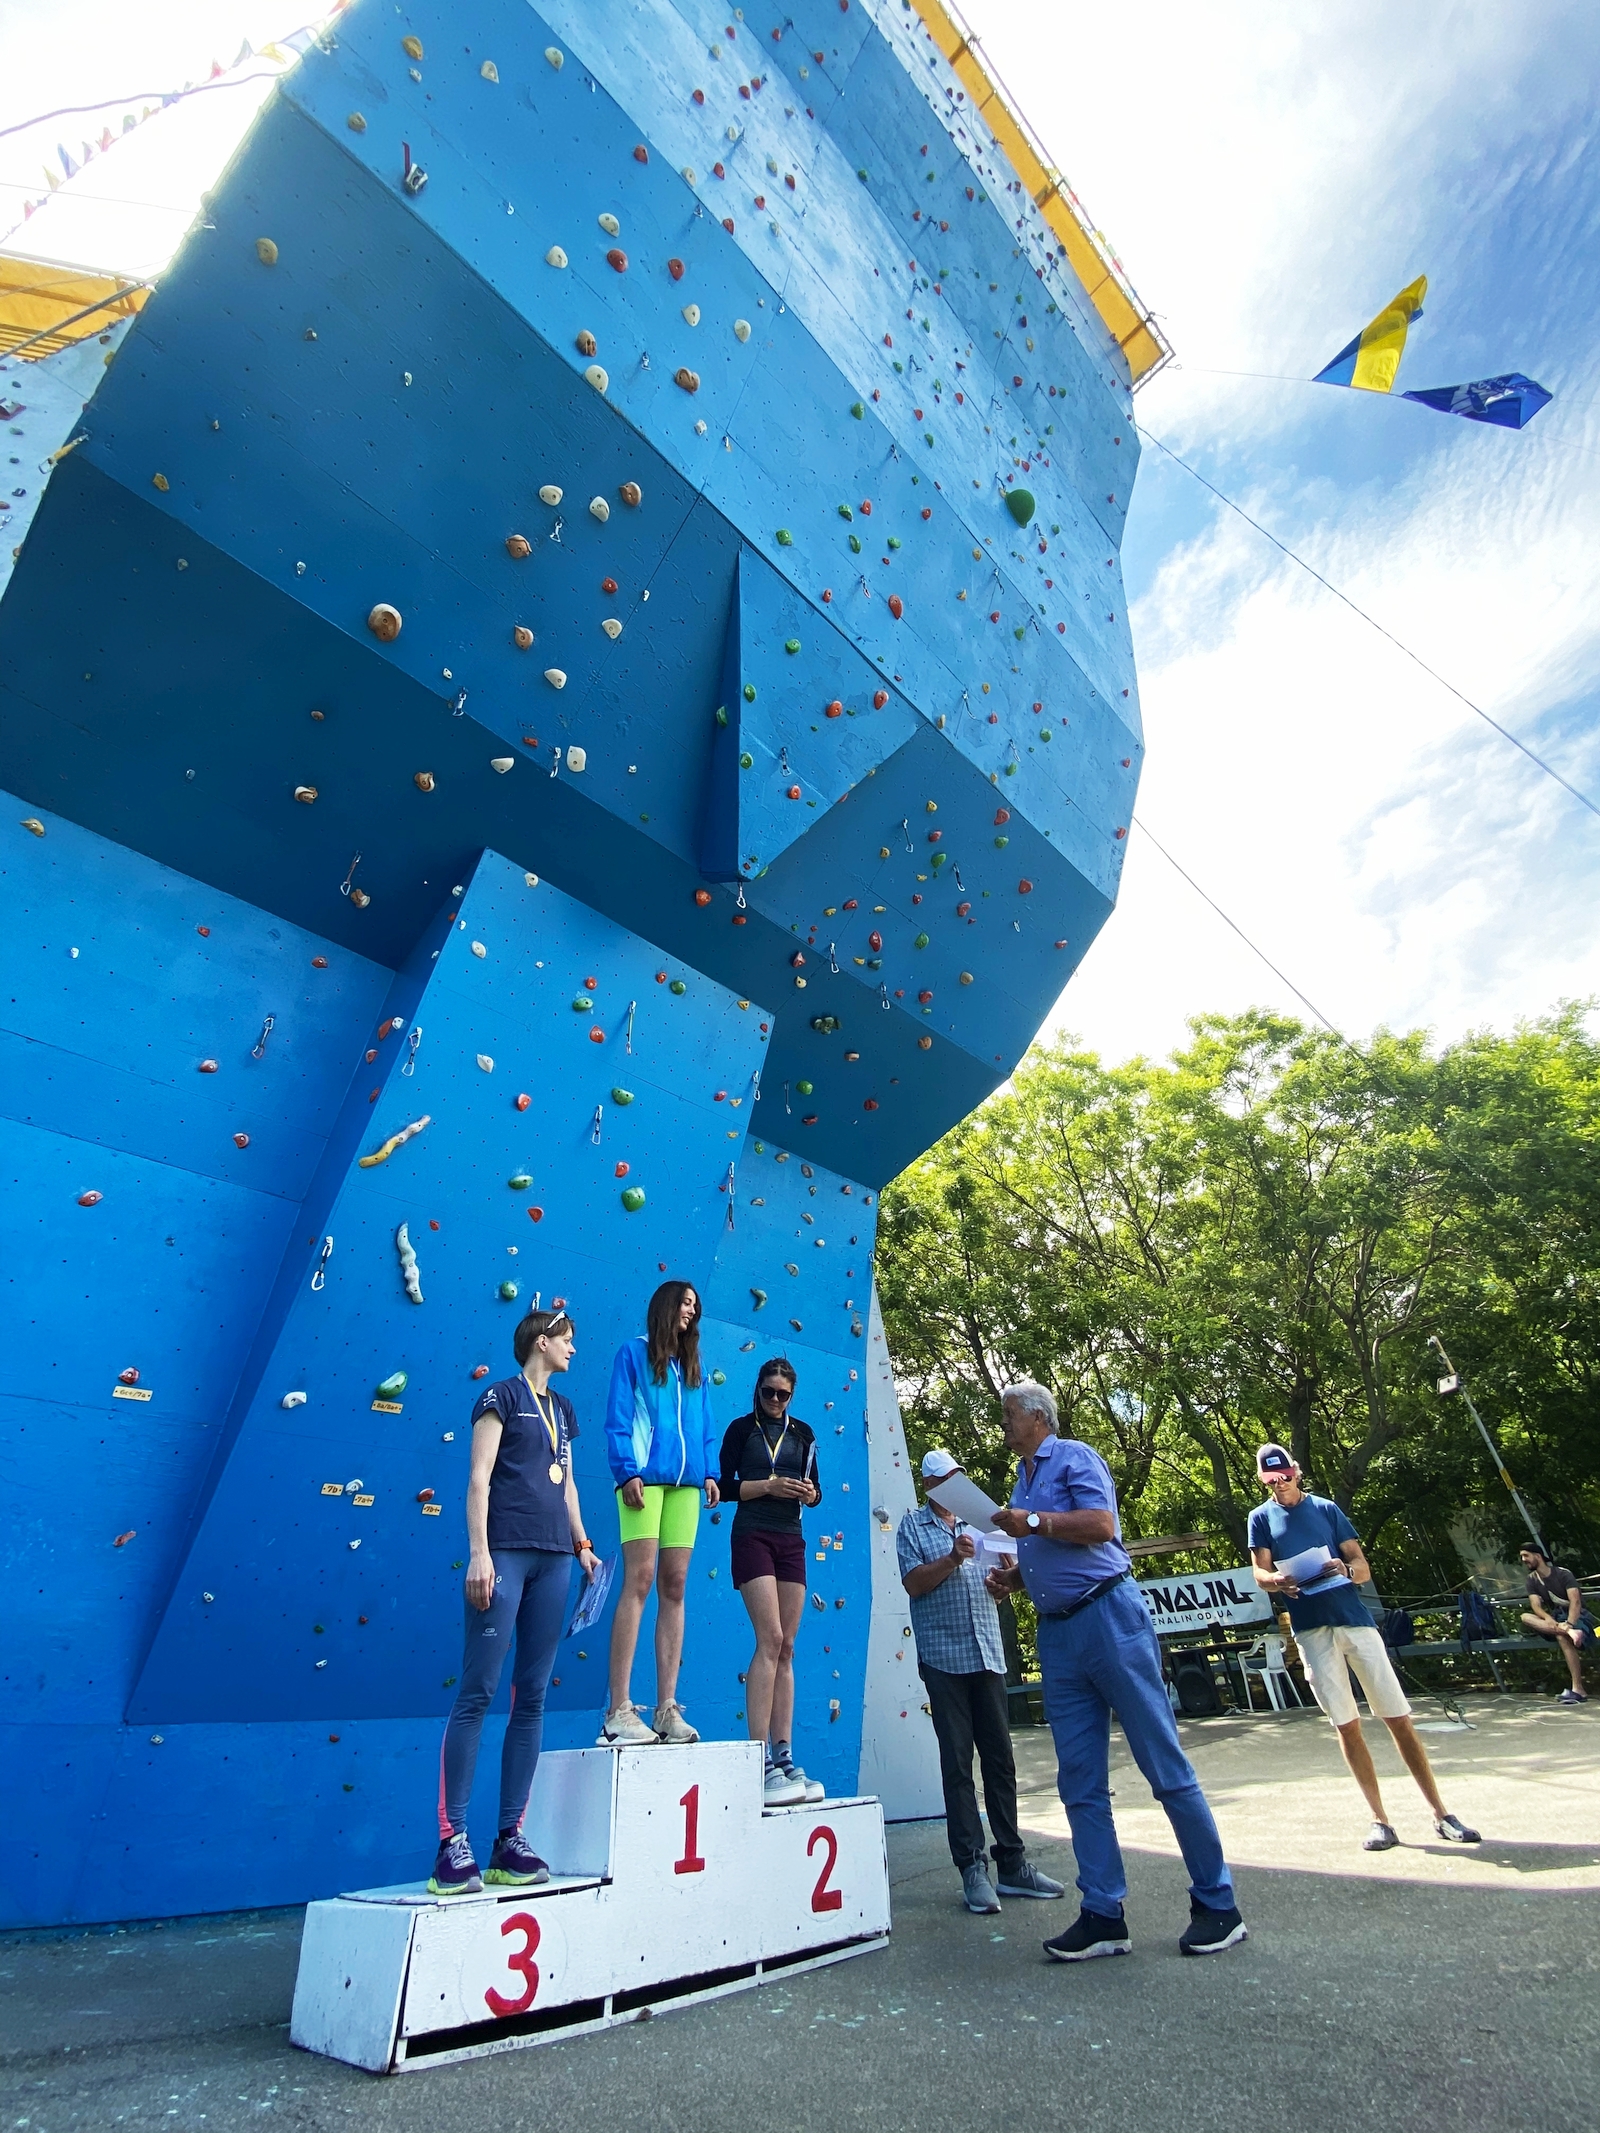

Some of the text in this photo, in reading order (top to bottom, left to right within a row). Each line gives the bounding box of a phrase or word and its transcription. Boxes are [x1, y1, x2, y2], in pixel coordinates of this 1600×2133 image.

[327, 1485, 338, 1493] 7b
[674, 1784, 705, 1875] 1
[807, 1825, 843, 1913] 2
[484, 1911, 542, 2018] 3
